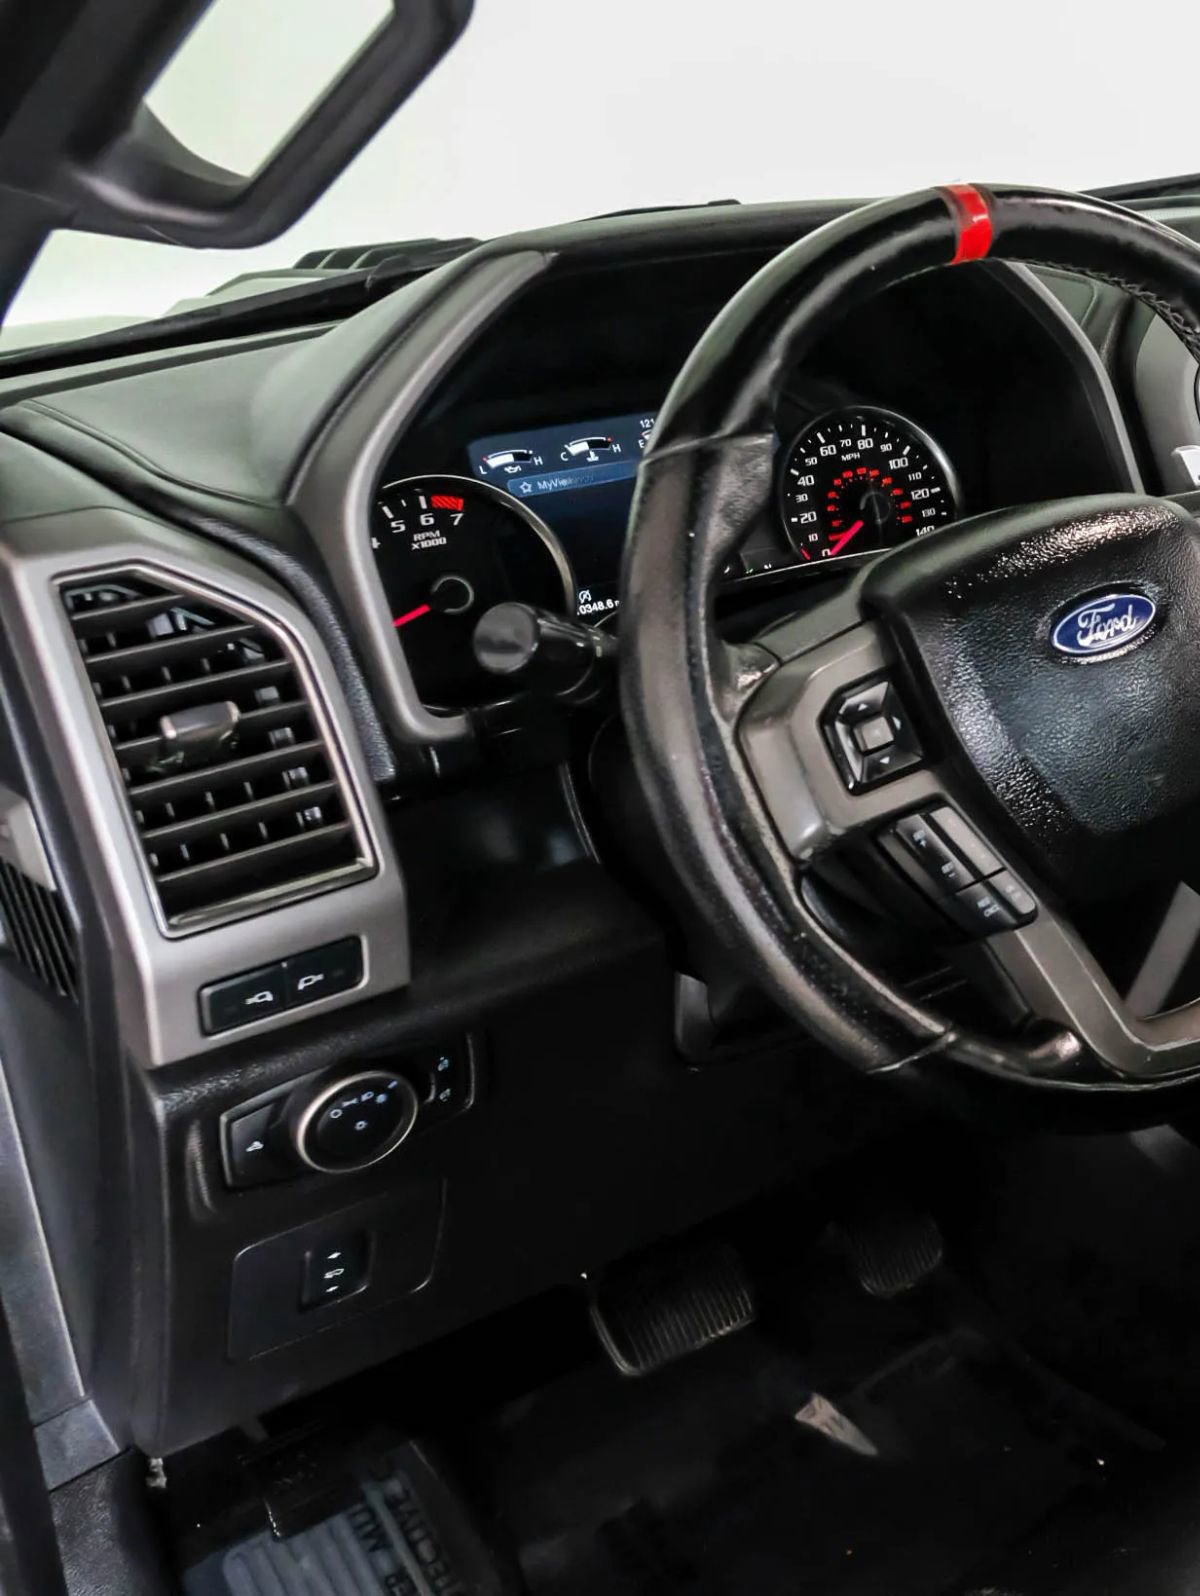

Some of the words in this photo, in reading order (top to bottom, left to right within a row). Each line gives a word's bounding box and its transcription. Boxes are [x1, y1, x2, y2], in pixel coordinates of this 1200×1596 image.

[612, 443, 621, 453] H
[638, 439, 646, 448] E
[840, 438, 852, 448] 70
[857, 438, 874, 450] 80
[880, 443, 892, 453] 90
[820, 444, 837, 457] 60
[534, 456, 543, 466] H
[560, 452, 569, 461] C
[805, 456, 818, 466] 50
[841, 452, 861, 462] MPH
[888, 457, 909, 470] 100
[479, 465, 487, 475] L
[797, 474, 815, 487] 40
[908, 472, 922, 481] 110
[795, 493, 808, 503] 30
[911, 488, 930, 500] 120
[800, 511, 817, 524] 20
[921, 508, 936, 518] 130
[420, 513, 435, 526] 6
[450, 513, 464, 526] 7
[391, 520, 406, 533] 5
[413, 530, 441, 541] RPM
[808, 533, 819, 542] 10
[576, 598, 614, 616] 0348.6
[1076, 603, 1140, 647] Ford
